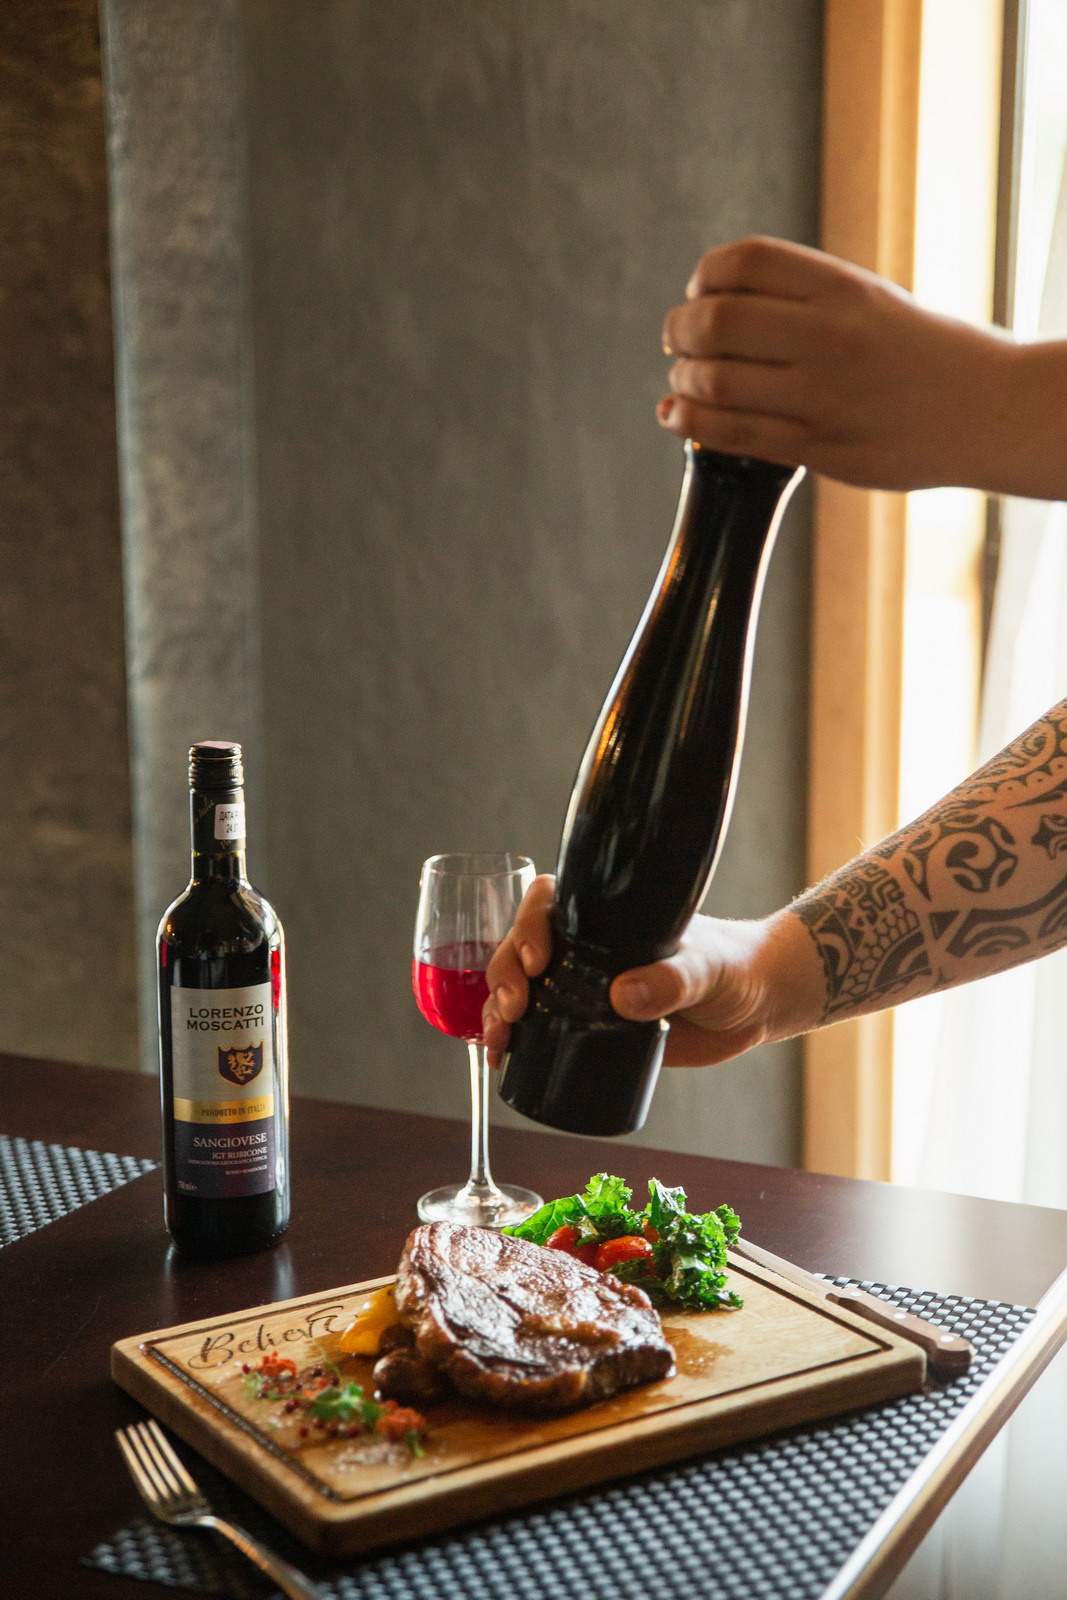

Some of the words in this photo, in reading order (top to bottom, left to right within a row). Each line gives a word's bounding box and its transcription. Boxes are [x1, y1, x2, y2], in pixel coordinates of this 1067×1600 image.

[189, 1004, 264, 1019] LORENZO
[186, 1016, 264, 1031] MOSCATTI
[201, 1108, 237, 1118] PRODOTTO
[193, 1132, 268, 1148] SANGIOVESE
[212, 1152, 226, 1160] IGT
[227, 1146, 268, 1159] RUBICONE
